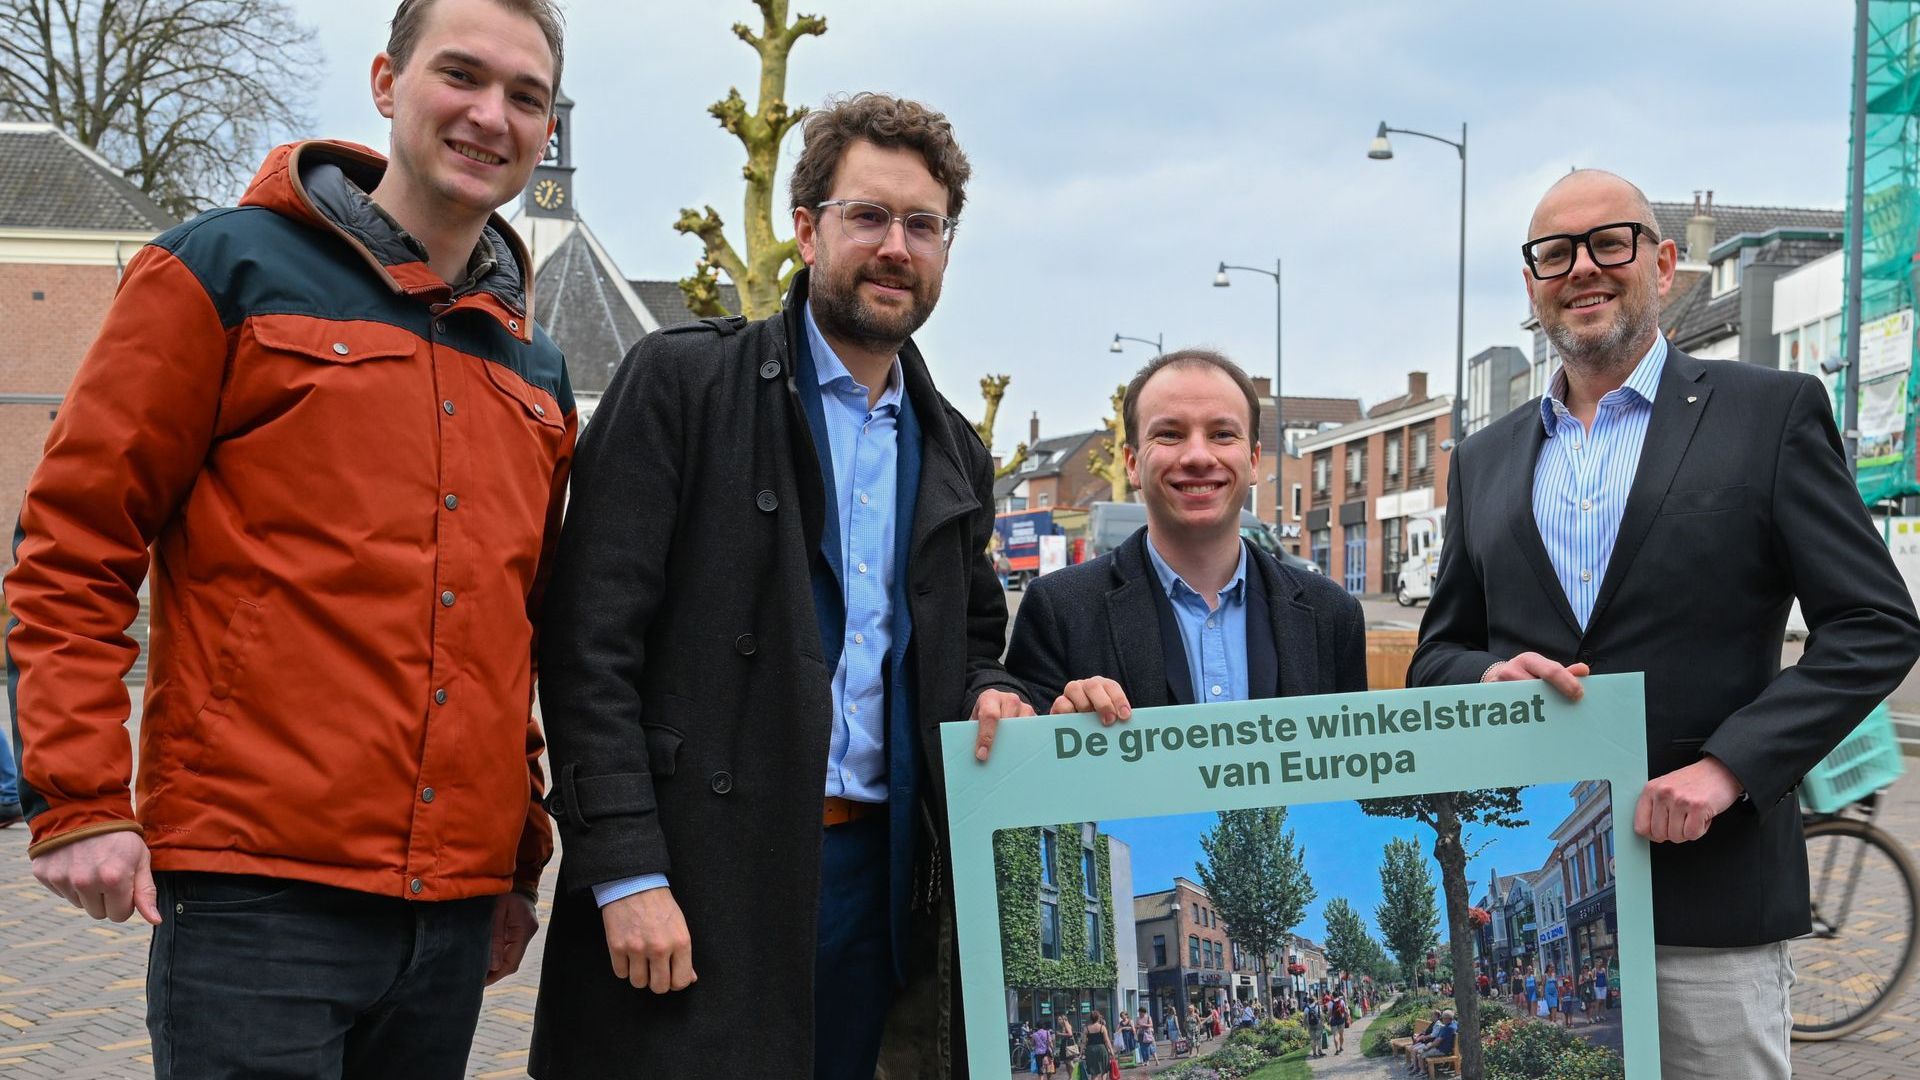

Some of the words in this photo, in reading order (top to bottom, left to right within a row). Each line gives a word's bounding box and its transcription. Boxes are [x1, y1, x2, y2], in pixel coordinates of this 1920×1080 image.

[1055, 728, 1109, 759] De
[1119, 715, 1298, 763] groenste
[1306, 694, 1546, 740] winkelstraat
[1198, 761, 1271, 789] van
[1280, 750, 1416, 785] Europa
